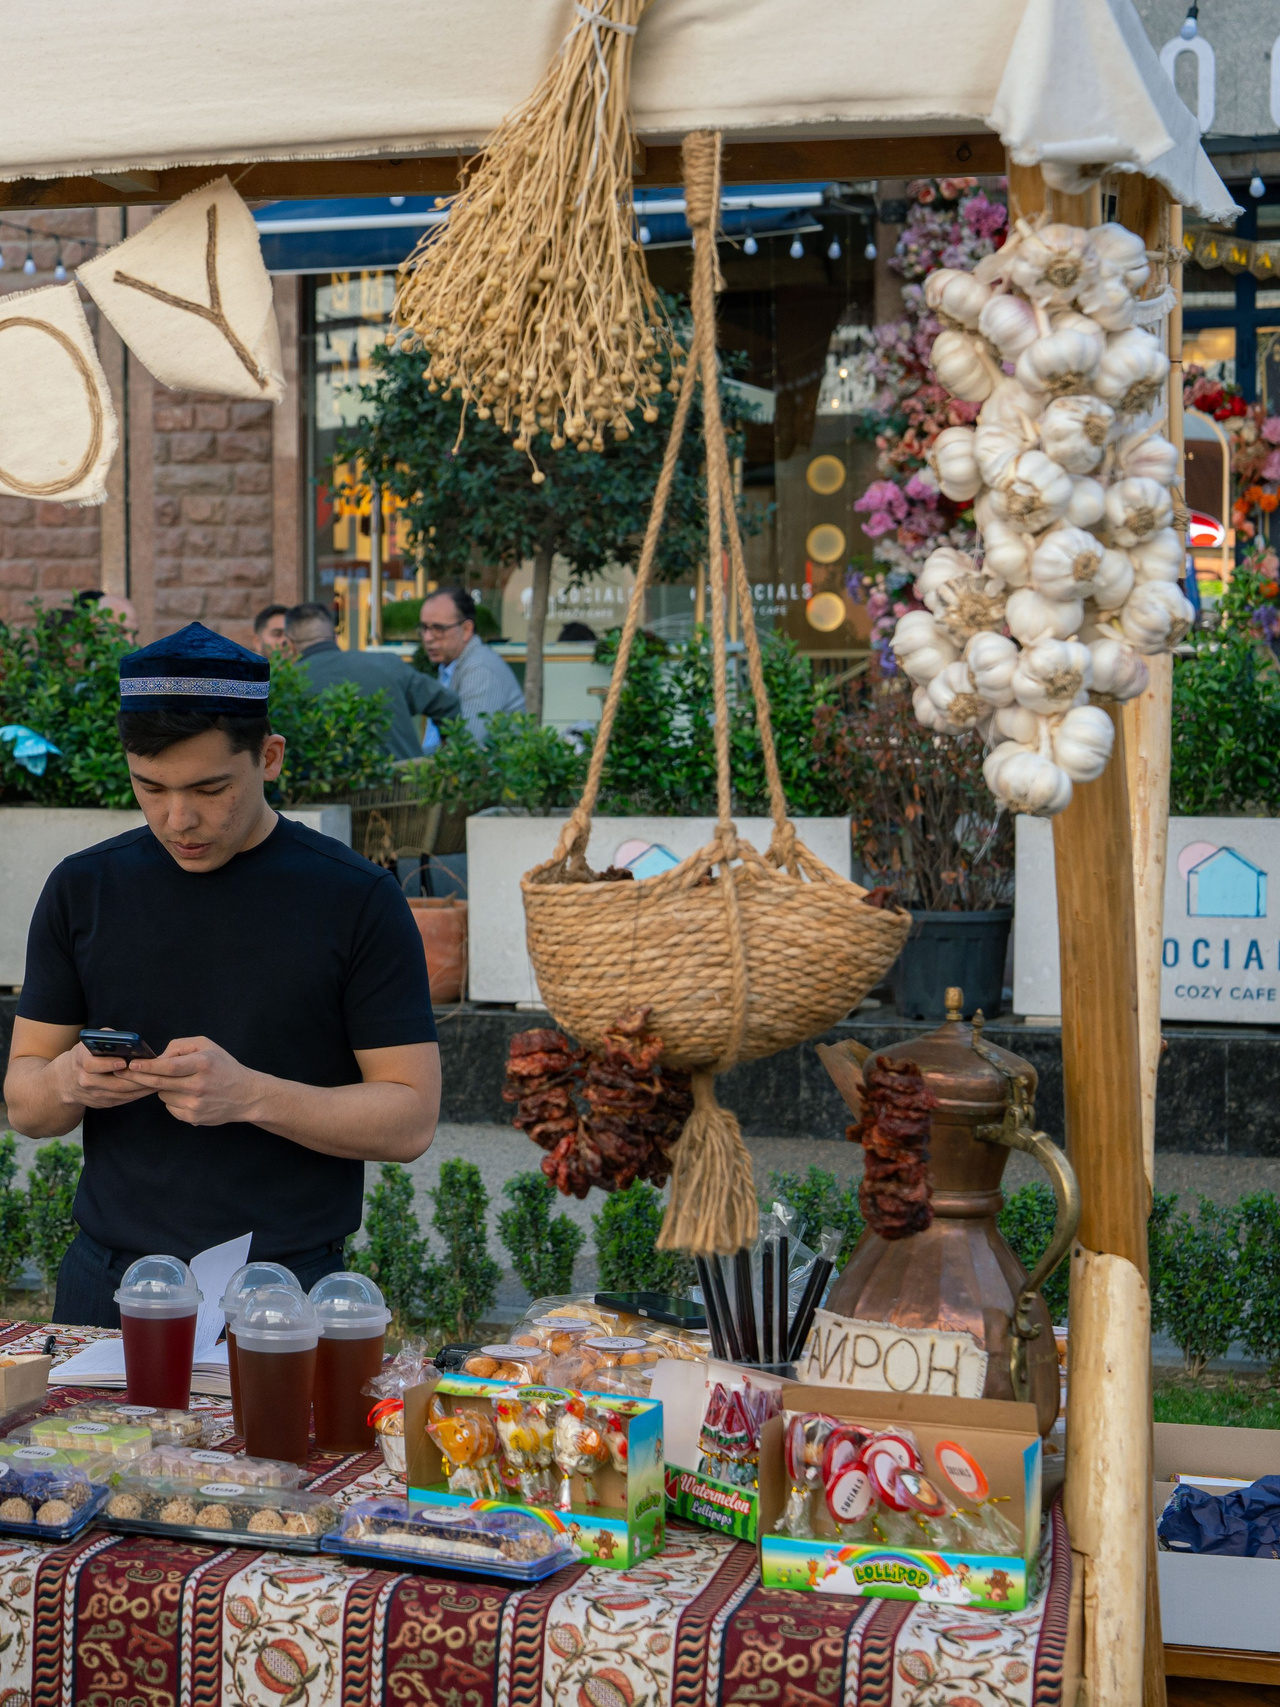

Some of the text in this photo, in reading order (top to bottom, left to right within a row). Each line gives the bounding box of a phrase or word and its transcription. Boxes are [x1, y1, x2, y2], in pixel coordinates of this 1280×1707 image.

[1174, 984, 1277, 1001] COZY CAFE
[681, 1473, 751, 1515] Watermelon
[840, 1477, 865, 1514] SOCIALS
[691, 1501, 733, 1526] Lollipops
